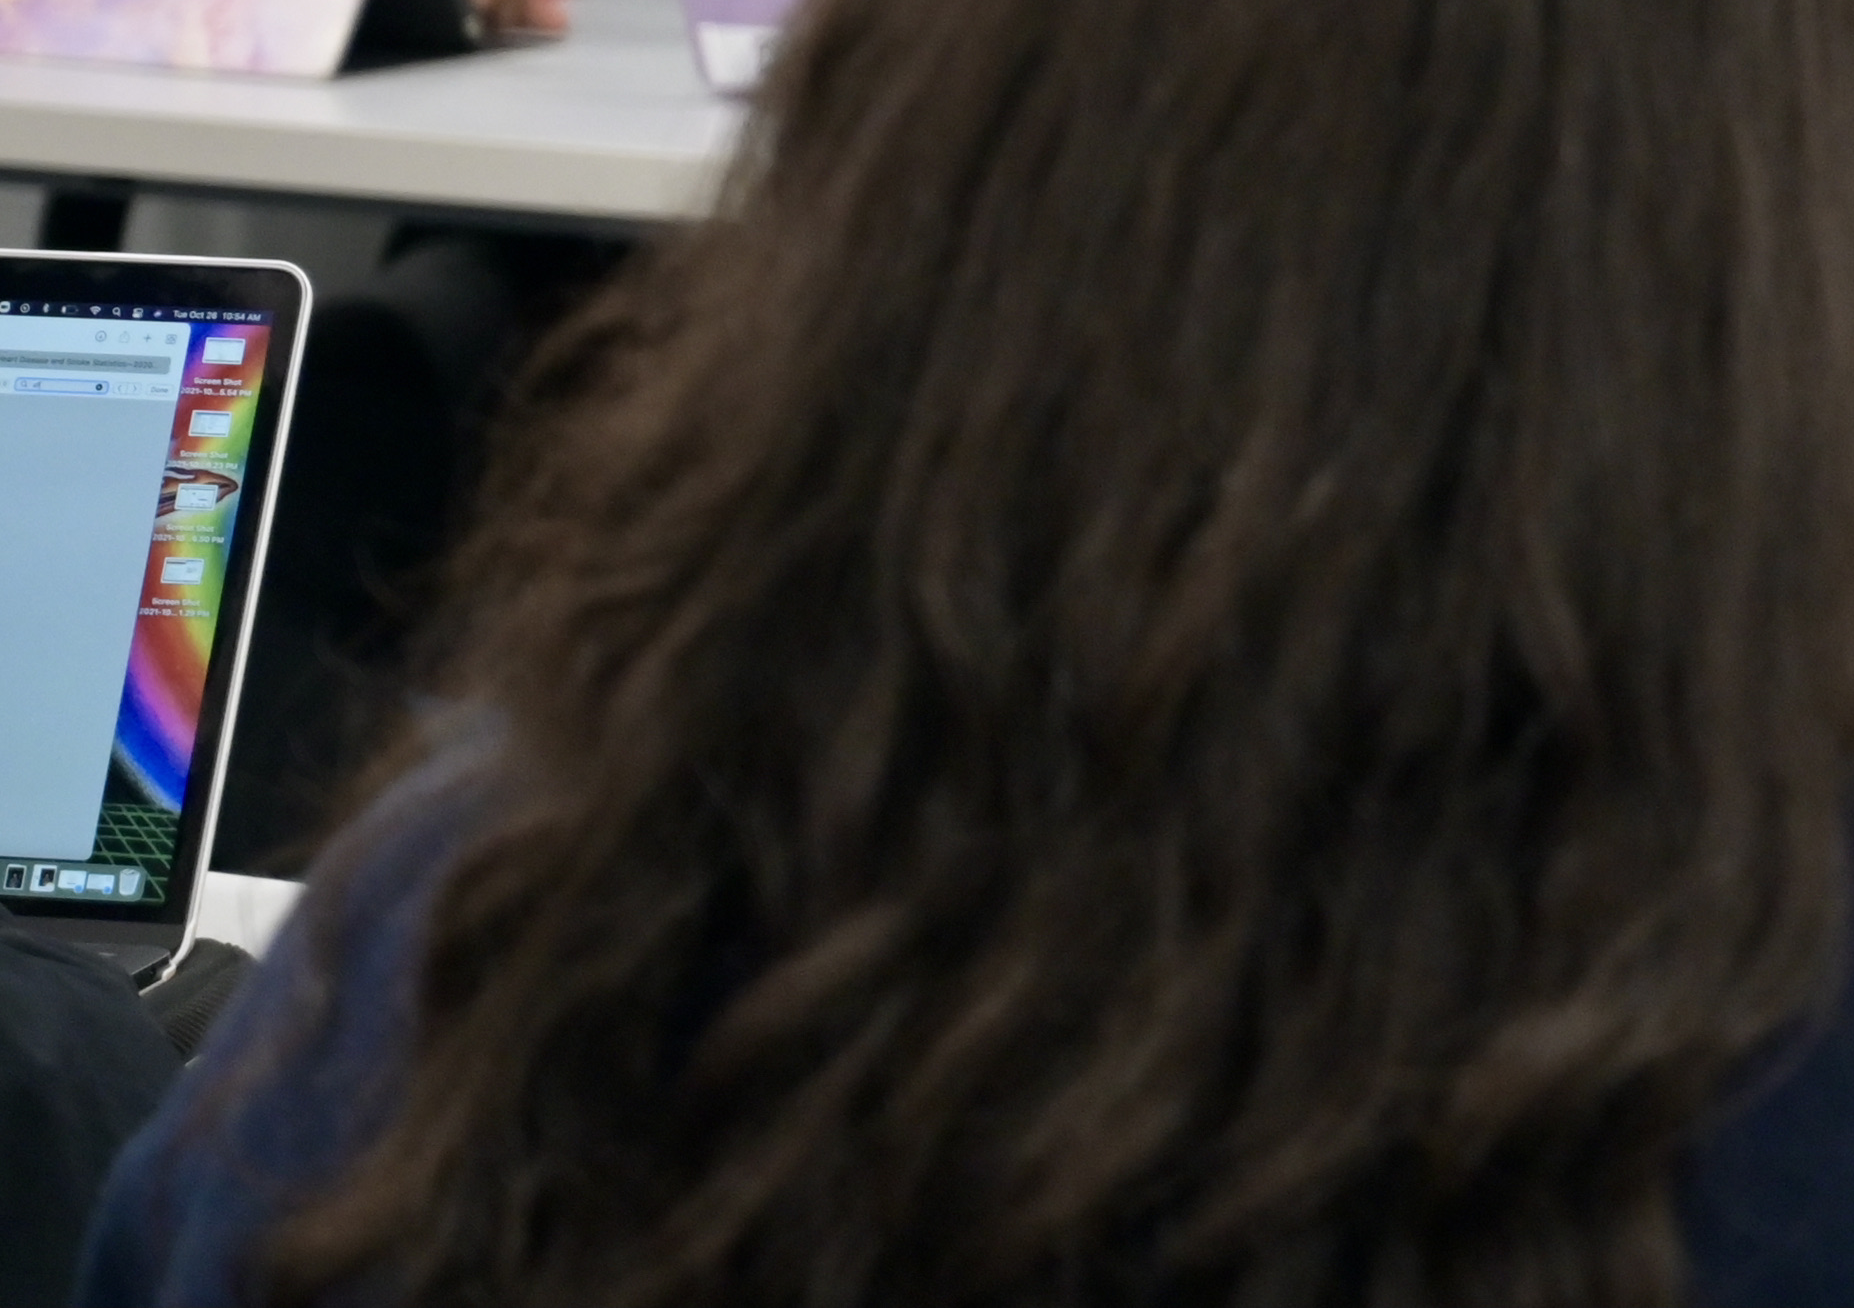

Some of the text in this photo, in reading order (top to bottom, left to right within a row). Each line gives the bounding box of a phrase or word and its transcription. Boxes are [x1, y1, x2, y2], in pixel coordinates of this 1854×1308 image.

[173, 309, 188, 320] Tue
[189, 310, 205, 320] Oct
[222, 311, 246, 322] 10:54
[247, 312, 262, 322] AM
[51, 357, 65, 366] and
[193, 377, 243, 386] Screen Shot
[180, 450, 228, 459] Screen Shot
[151, 597, 201, 607] Screen Shot
